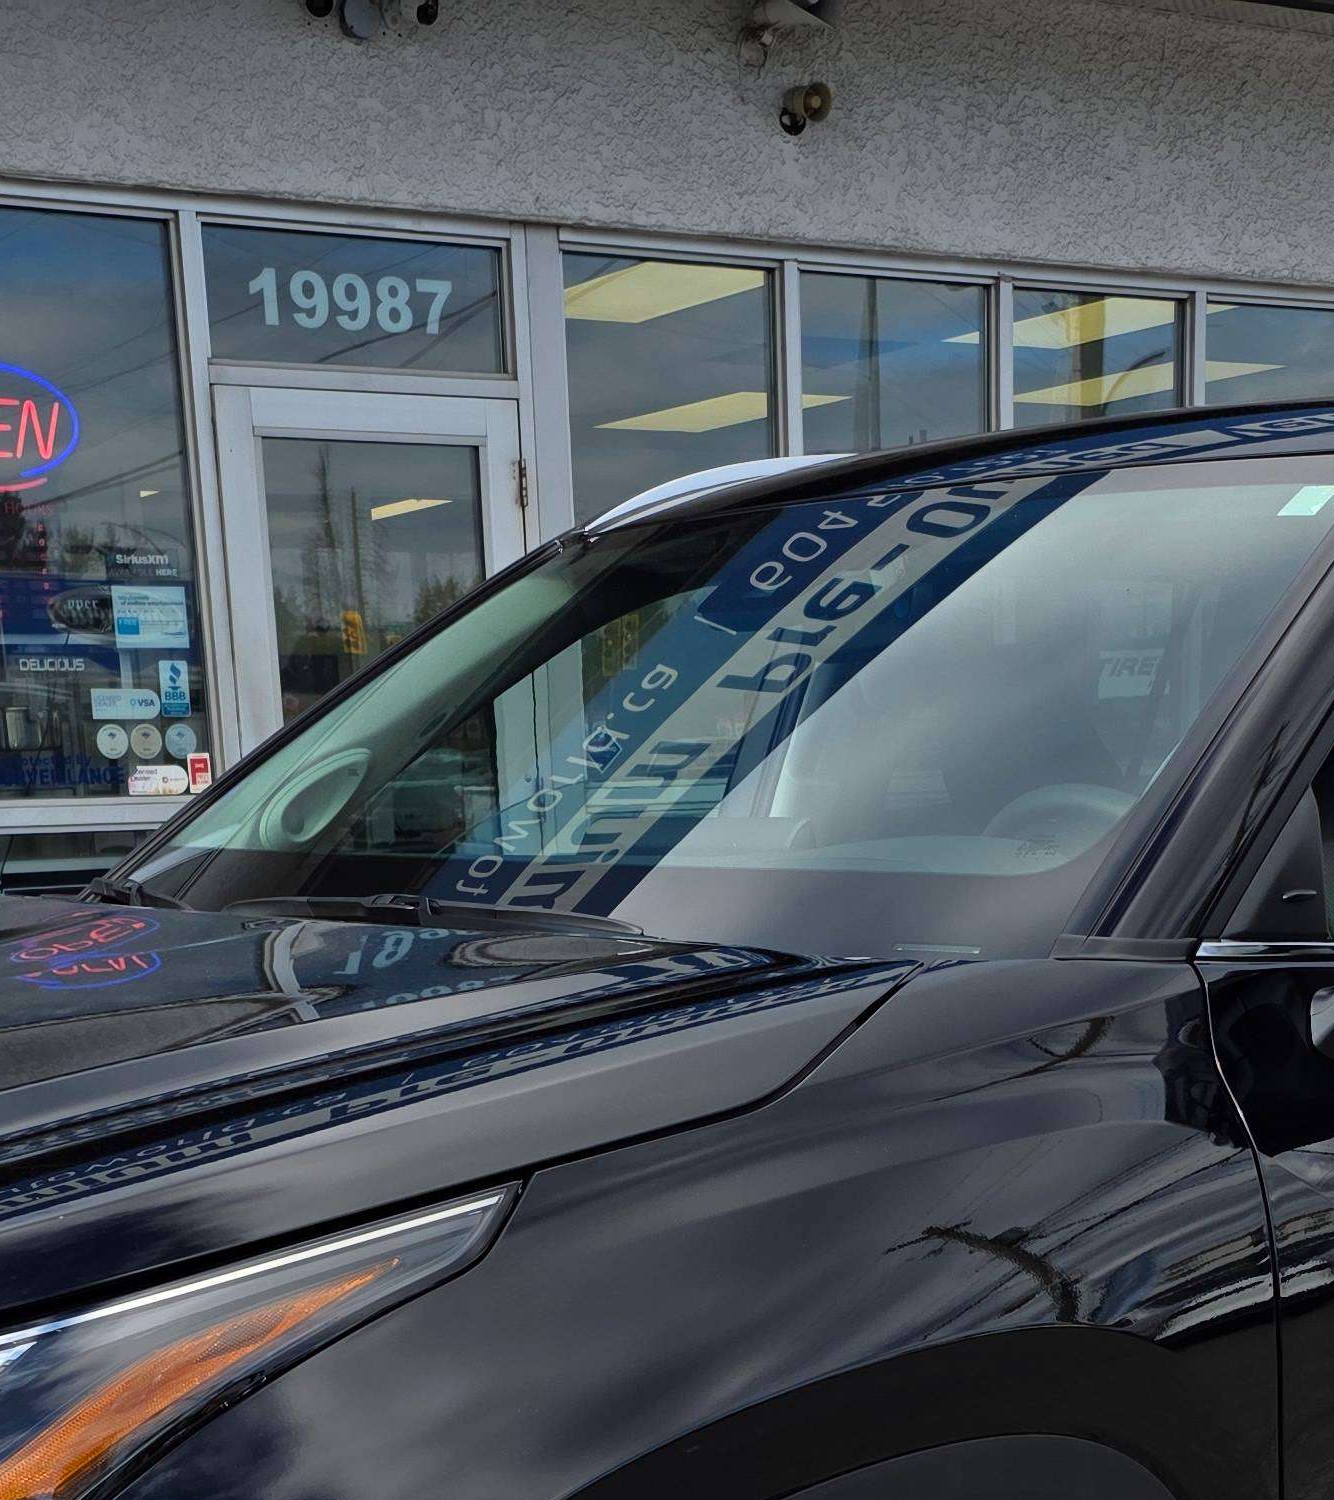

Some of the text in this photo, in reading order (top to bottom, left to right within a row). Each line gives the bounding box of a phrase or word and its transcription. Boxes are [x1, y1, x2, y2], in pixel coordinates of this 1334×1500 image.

[249, 266, 463, 335] 19987
[19, 657, 86, 672] DELICIOUS
[164, 691, 187, 701] BBB
[137, 698, 156, 707] VSA
